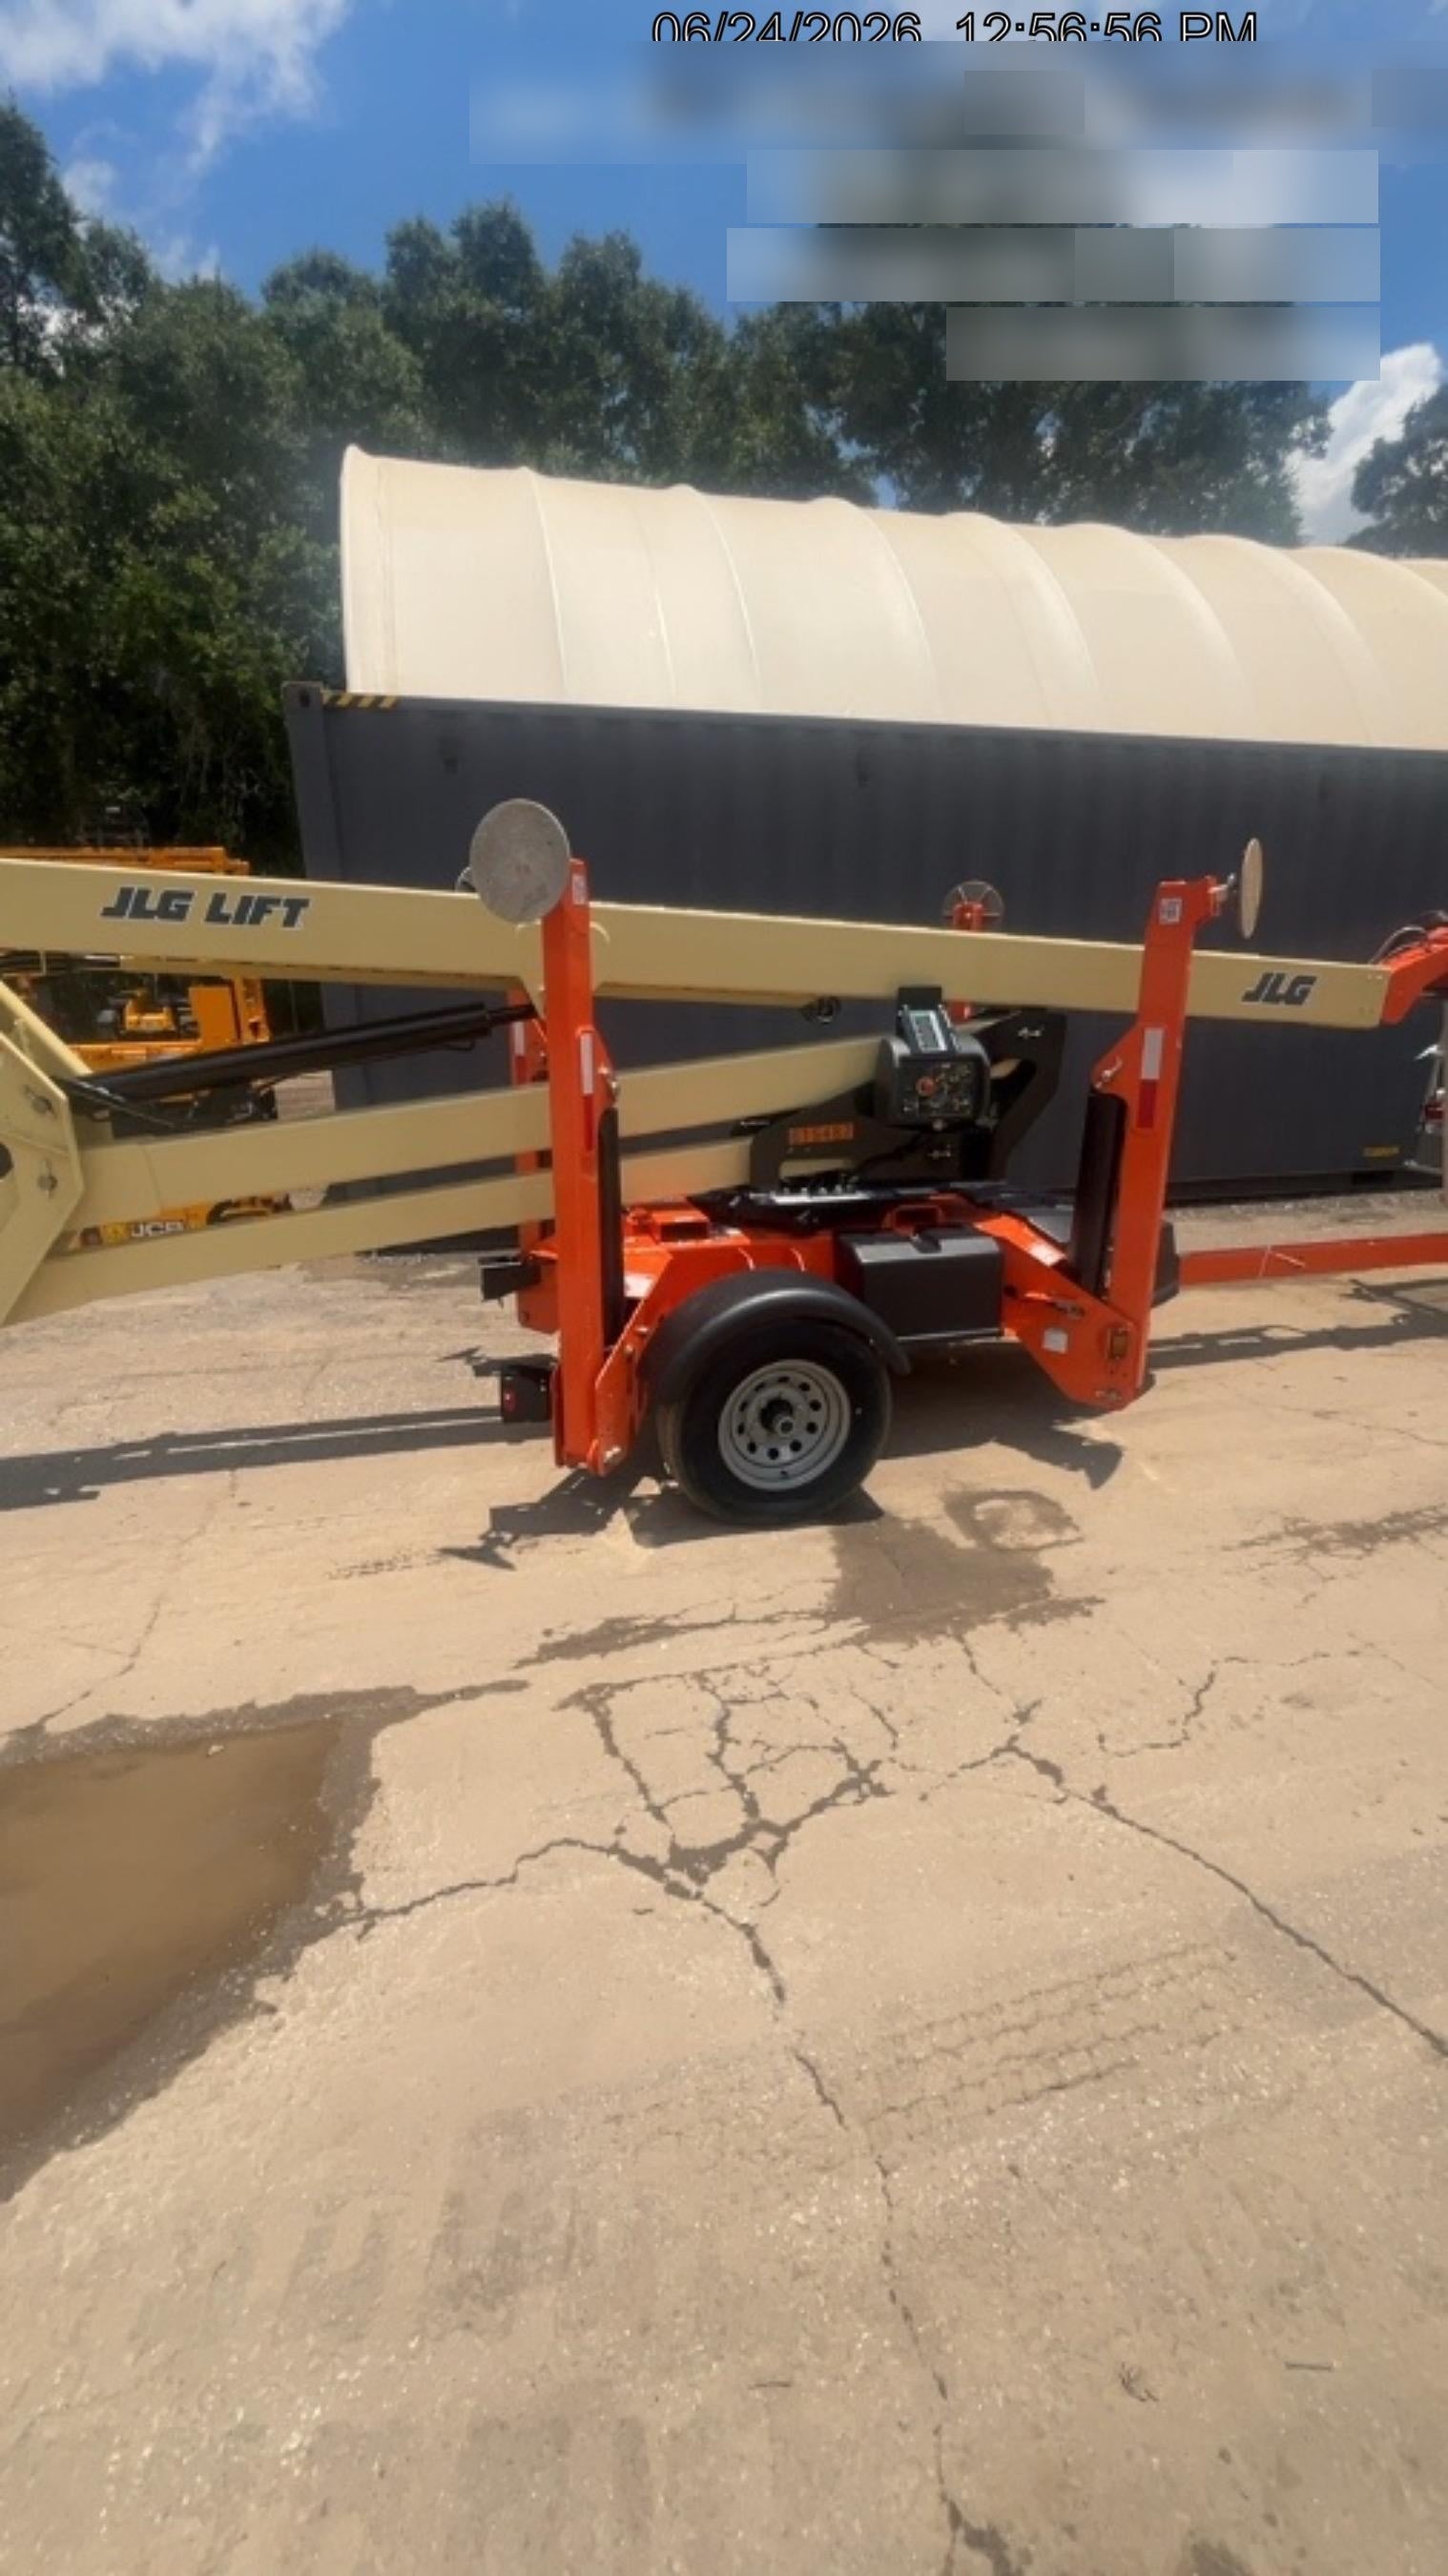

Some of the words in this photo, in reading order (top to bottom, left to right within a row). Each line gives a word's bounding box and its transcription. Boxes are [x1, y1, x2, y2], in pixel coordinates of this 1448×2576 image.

[100, 886, 195, 922] JLG
[204, 892, 310, 928] LIFT
[1241, 972, 1317, 1006] JLG
